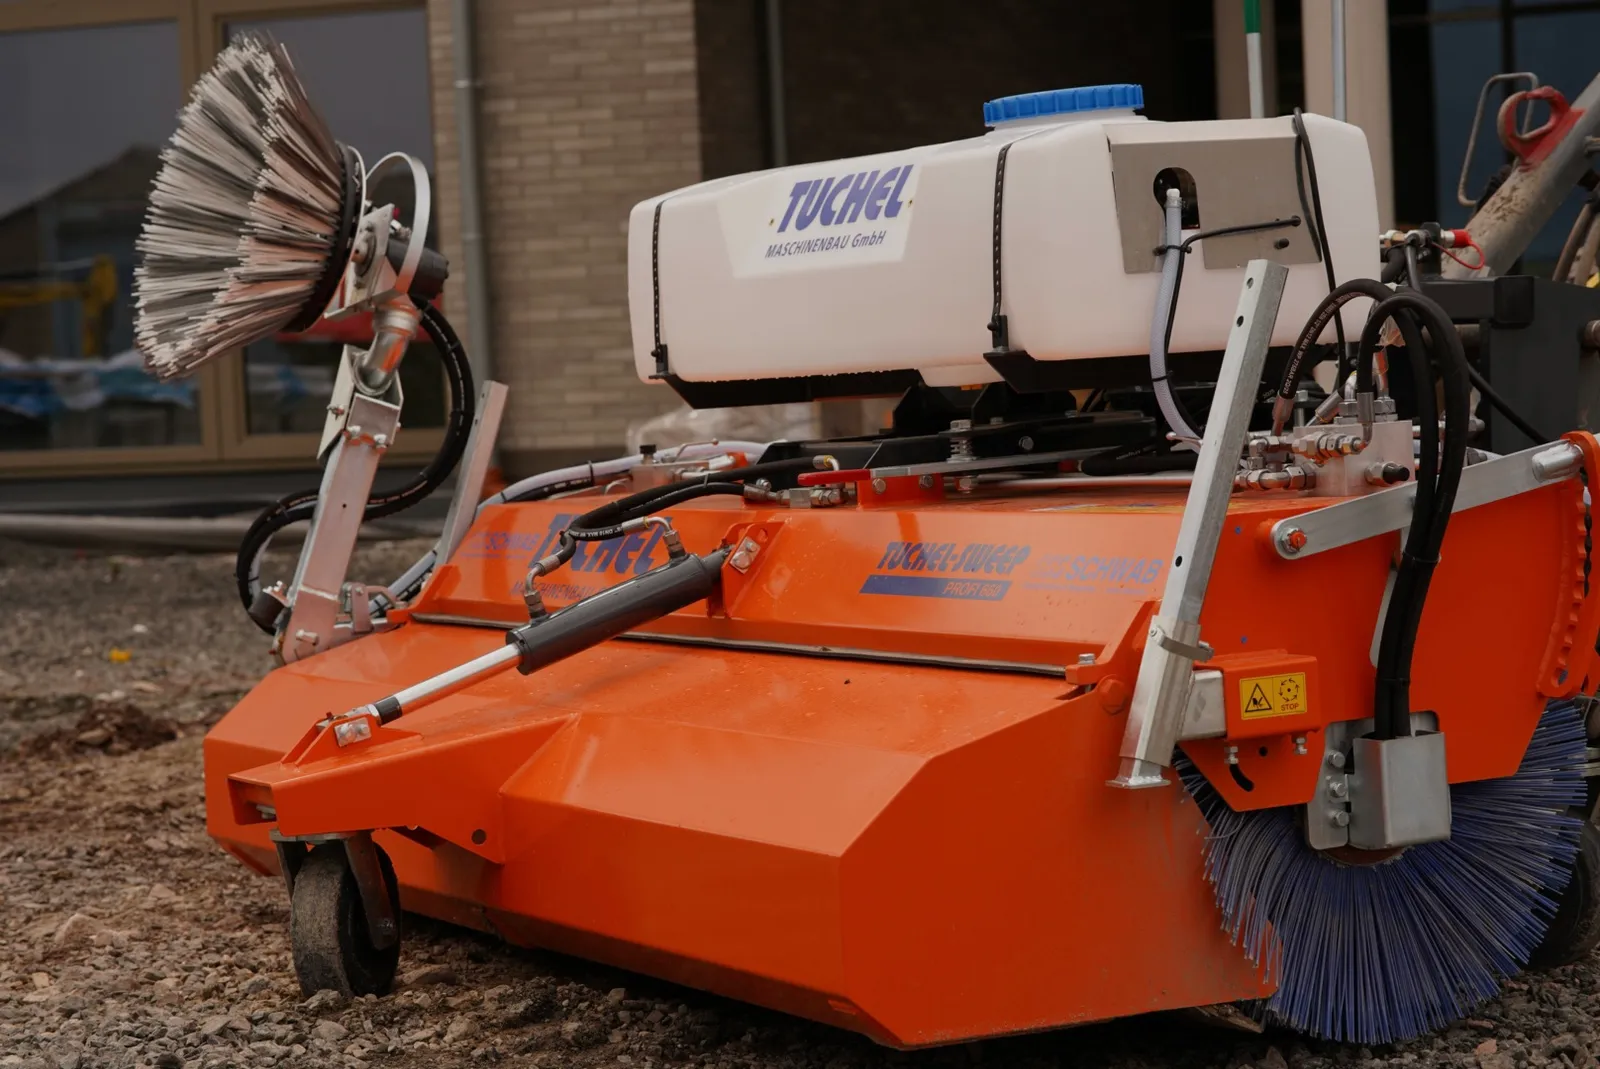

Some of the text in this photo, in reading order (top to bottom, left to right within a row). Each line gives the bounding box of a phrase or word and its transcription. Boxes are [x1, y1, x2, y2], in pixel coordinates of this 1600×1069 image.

[776, 164, 914, 233] TUCHEL
[765, 230, 887, 259] MASCHINENBAU GmbH
[876, 541, 1032, 576] TUCHEL-SWEEP
[1065, 555, 1164, 585] SCHWAB
[943, 581, 980, 597] PROFI
[1281, 702, 1299, 711] STOP
